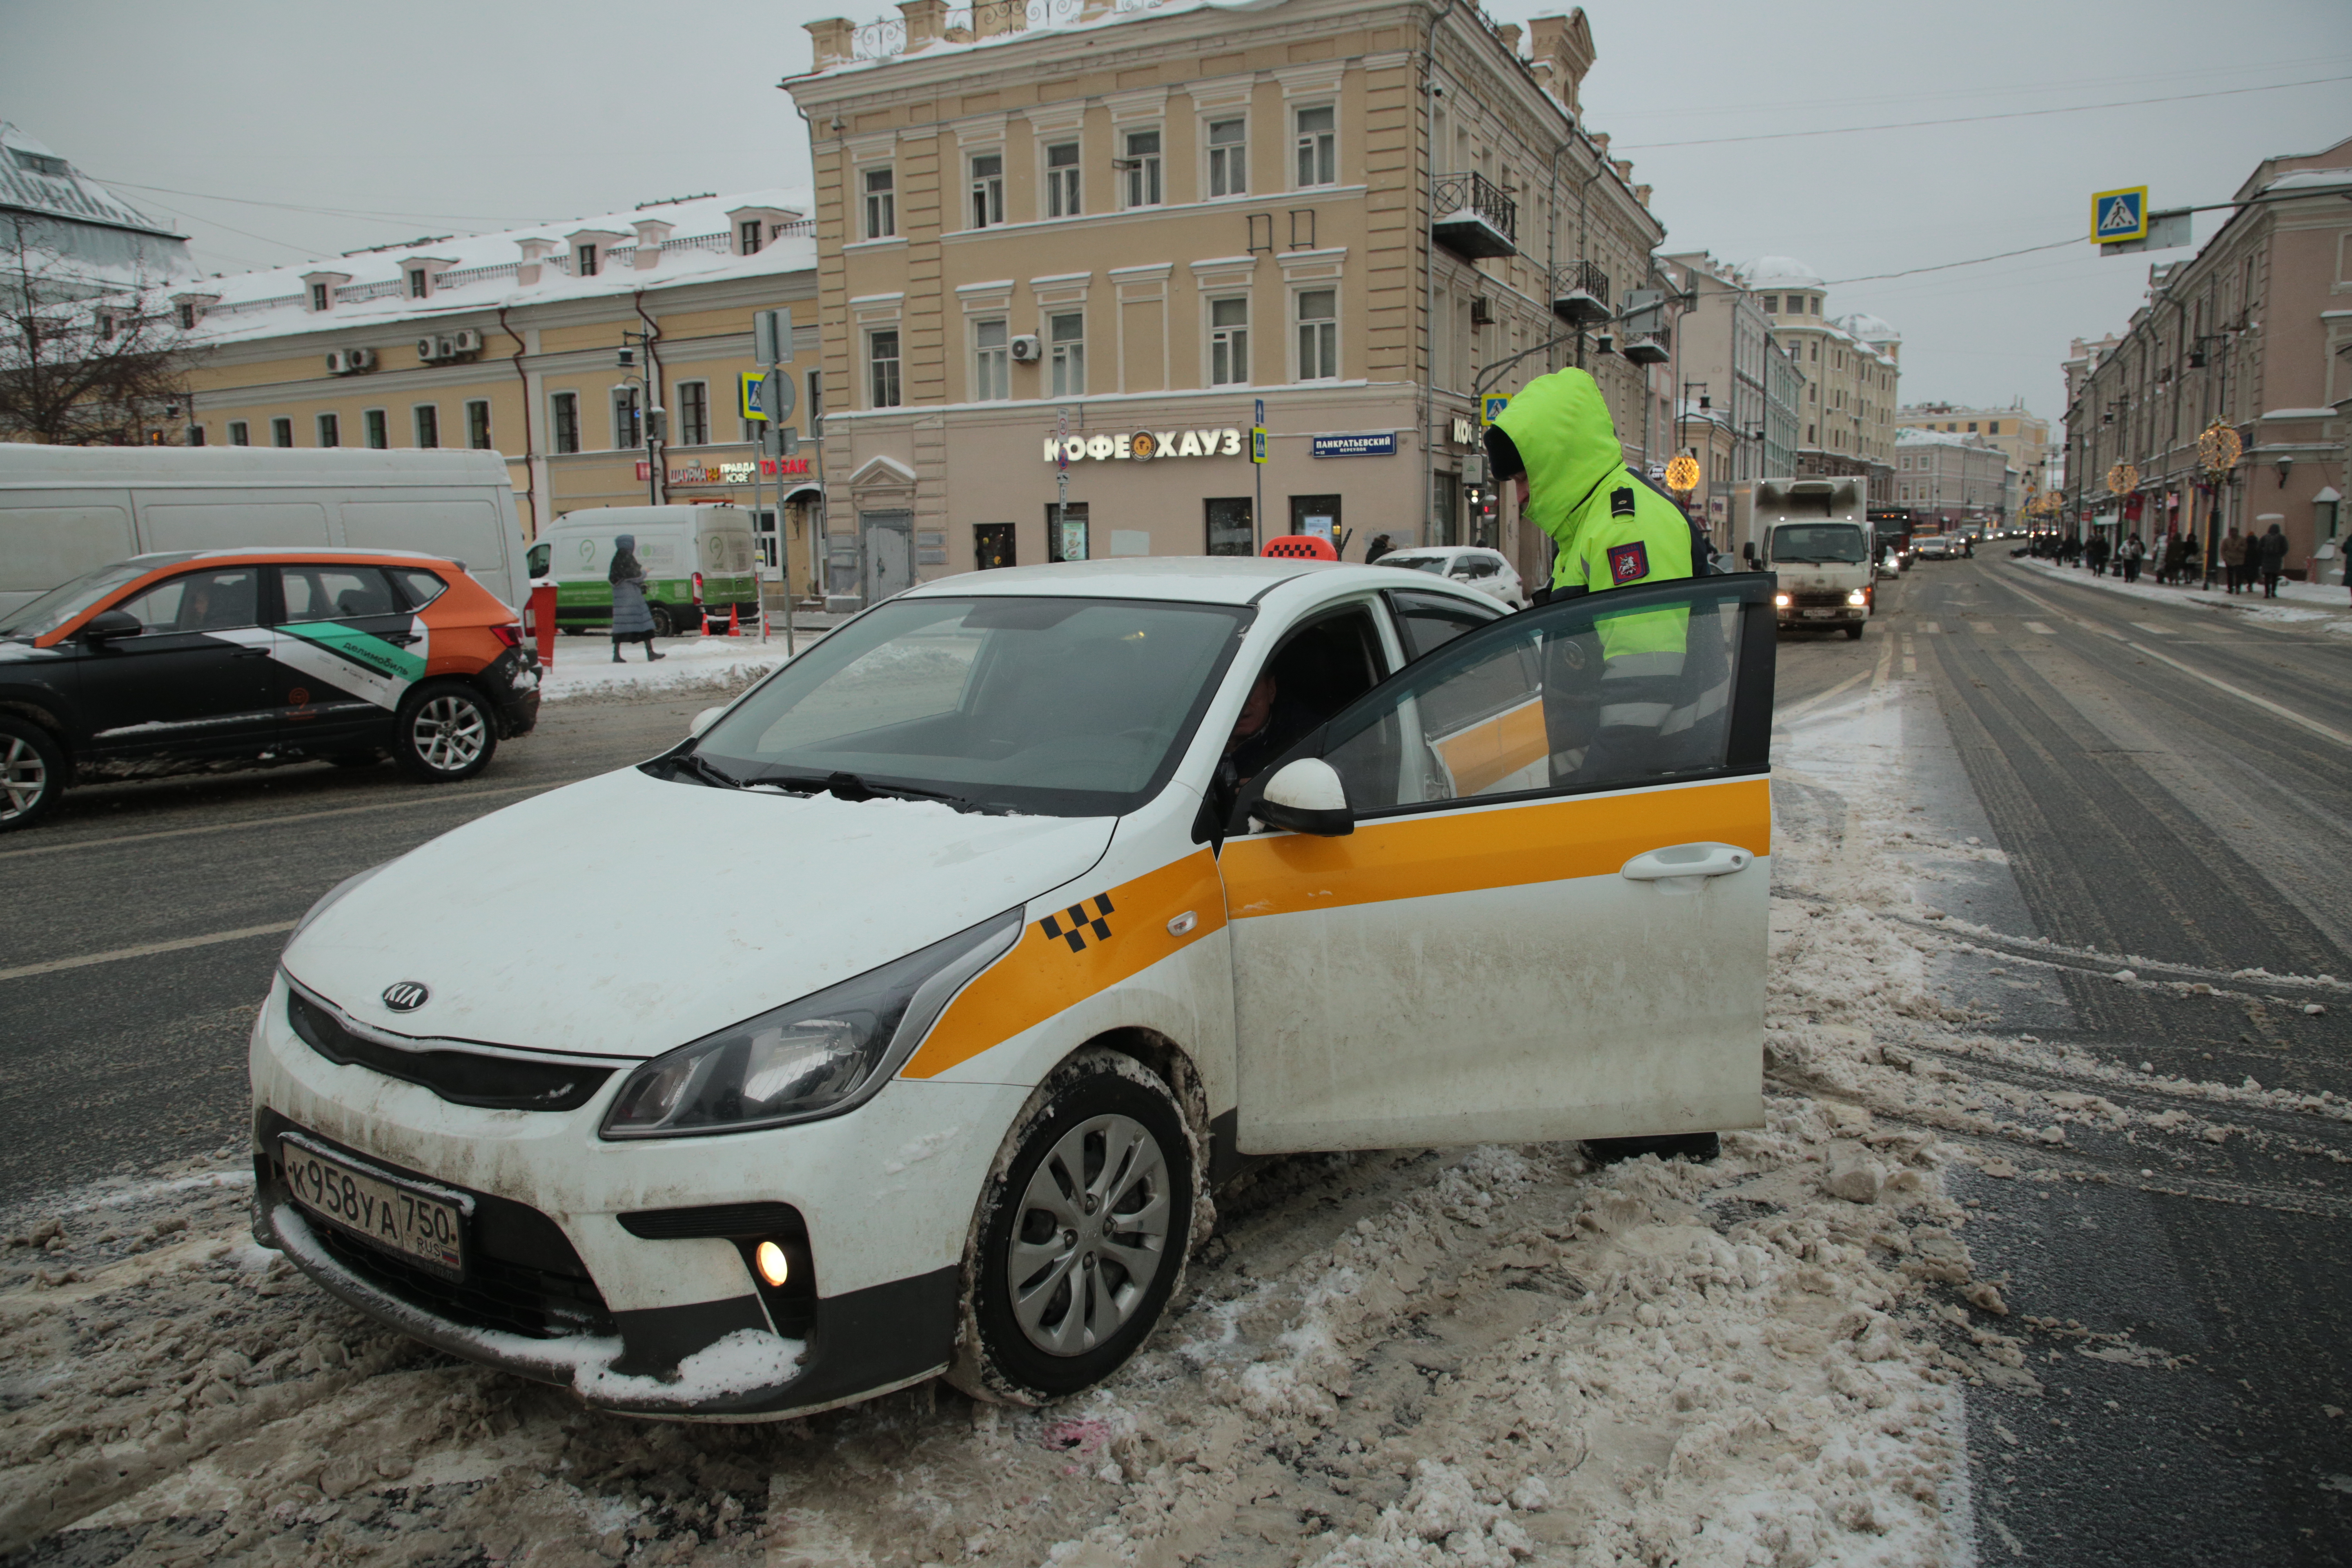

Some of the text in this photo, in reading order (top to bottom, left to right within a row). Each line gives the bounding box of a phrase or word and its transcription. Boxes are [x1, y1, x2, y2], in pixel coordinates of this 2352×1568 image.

[1044, 428, 1241, 462] КОФЕ ХАУЗ
[1316, 437, 1390, 448] ПАНКРАТЬЕВСКИЙ
[720, 462, 755, 473] ПРАВДА
[759, 459, 808, 475] ТАБАК
[670, 468, 707, 483] ШАУРМА
[726, 472, 748, 483] КОФЕ
[1614, 545, 1637, 554] МОСКВА
[343, 642, 409, 675] делимобиль
[384, 984, 423, 1007] KIA
[292, 1160, 398, 1240] К958УА
[400, 1194, 450, 1245] 750
[417, 1237, 441, 1257] RUS
